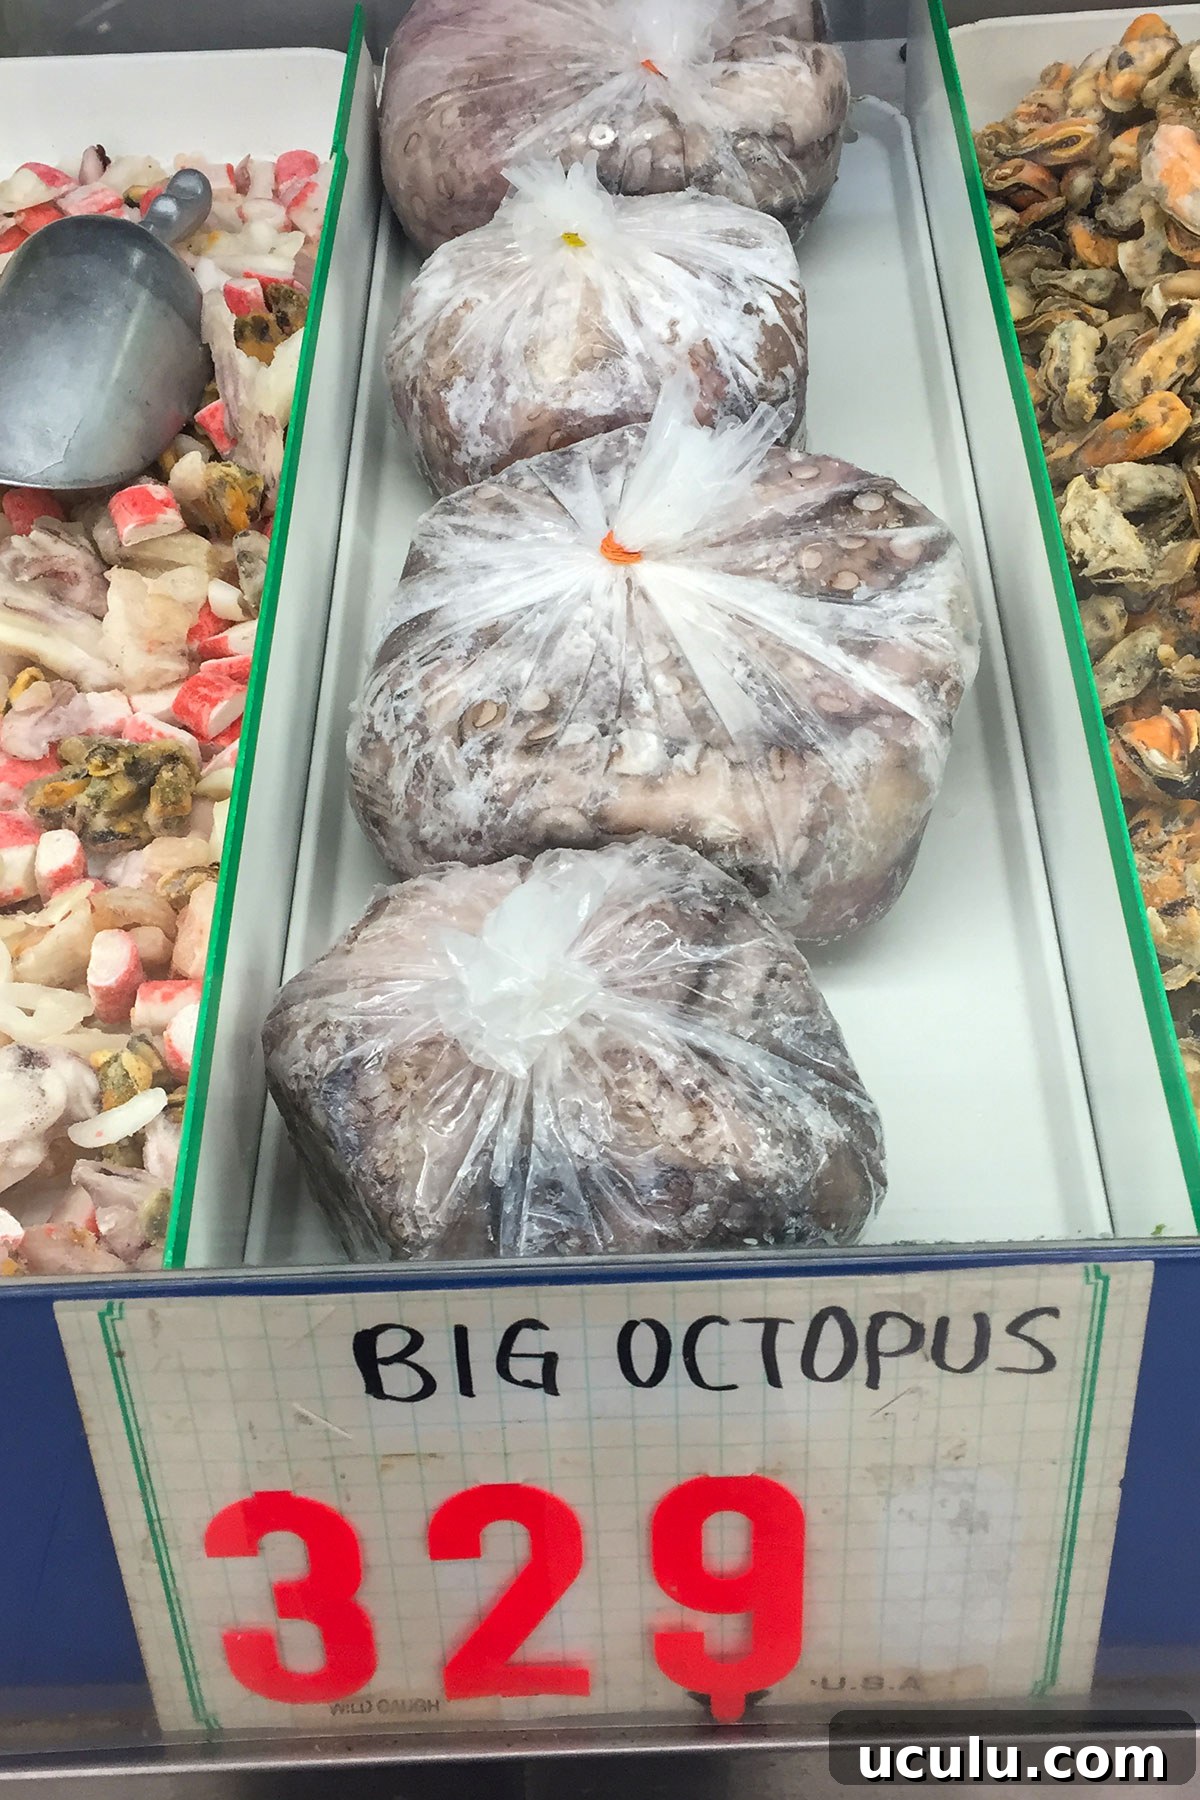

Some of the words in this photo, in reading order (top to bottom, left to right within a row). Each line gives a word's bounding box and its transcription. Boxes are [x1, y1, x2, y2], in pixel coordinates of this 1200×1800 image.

[352, 1318, 560, 1402] BIG
[616, 1305, 1061, 1391] OCTOPUS
[330, 1701, 373, 1716] WILD
